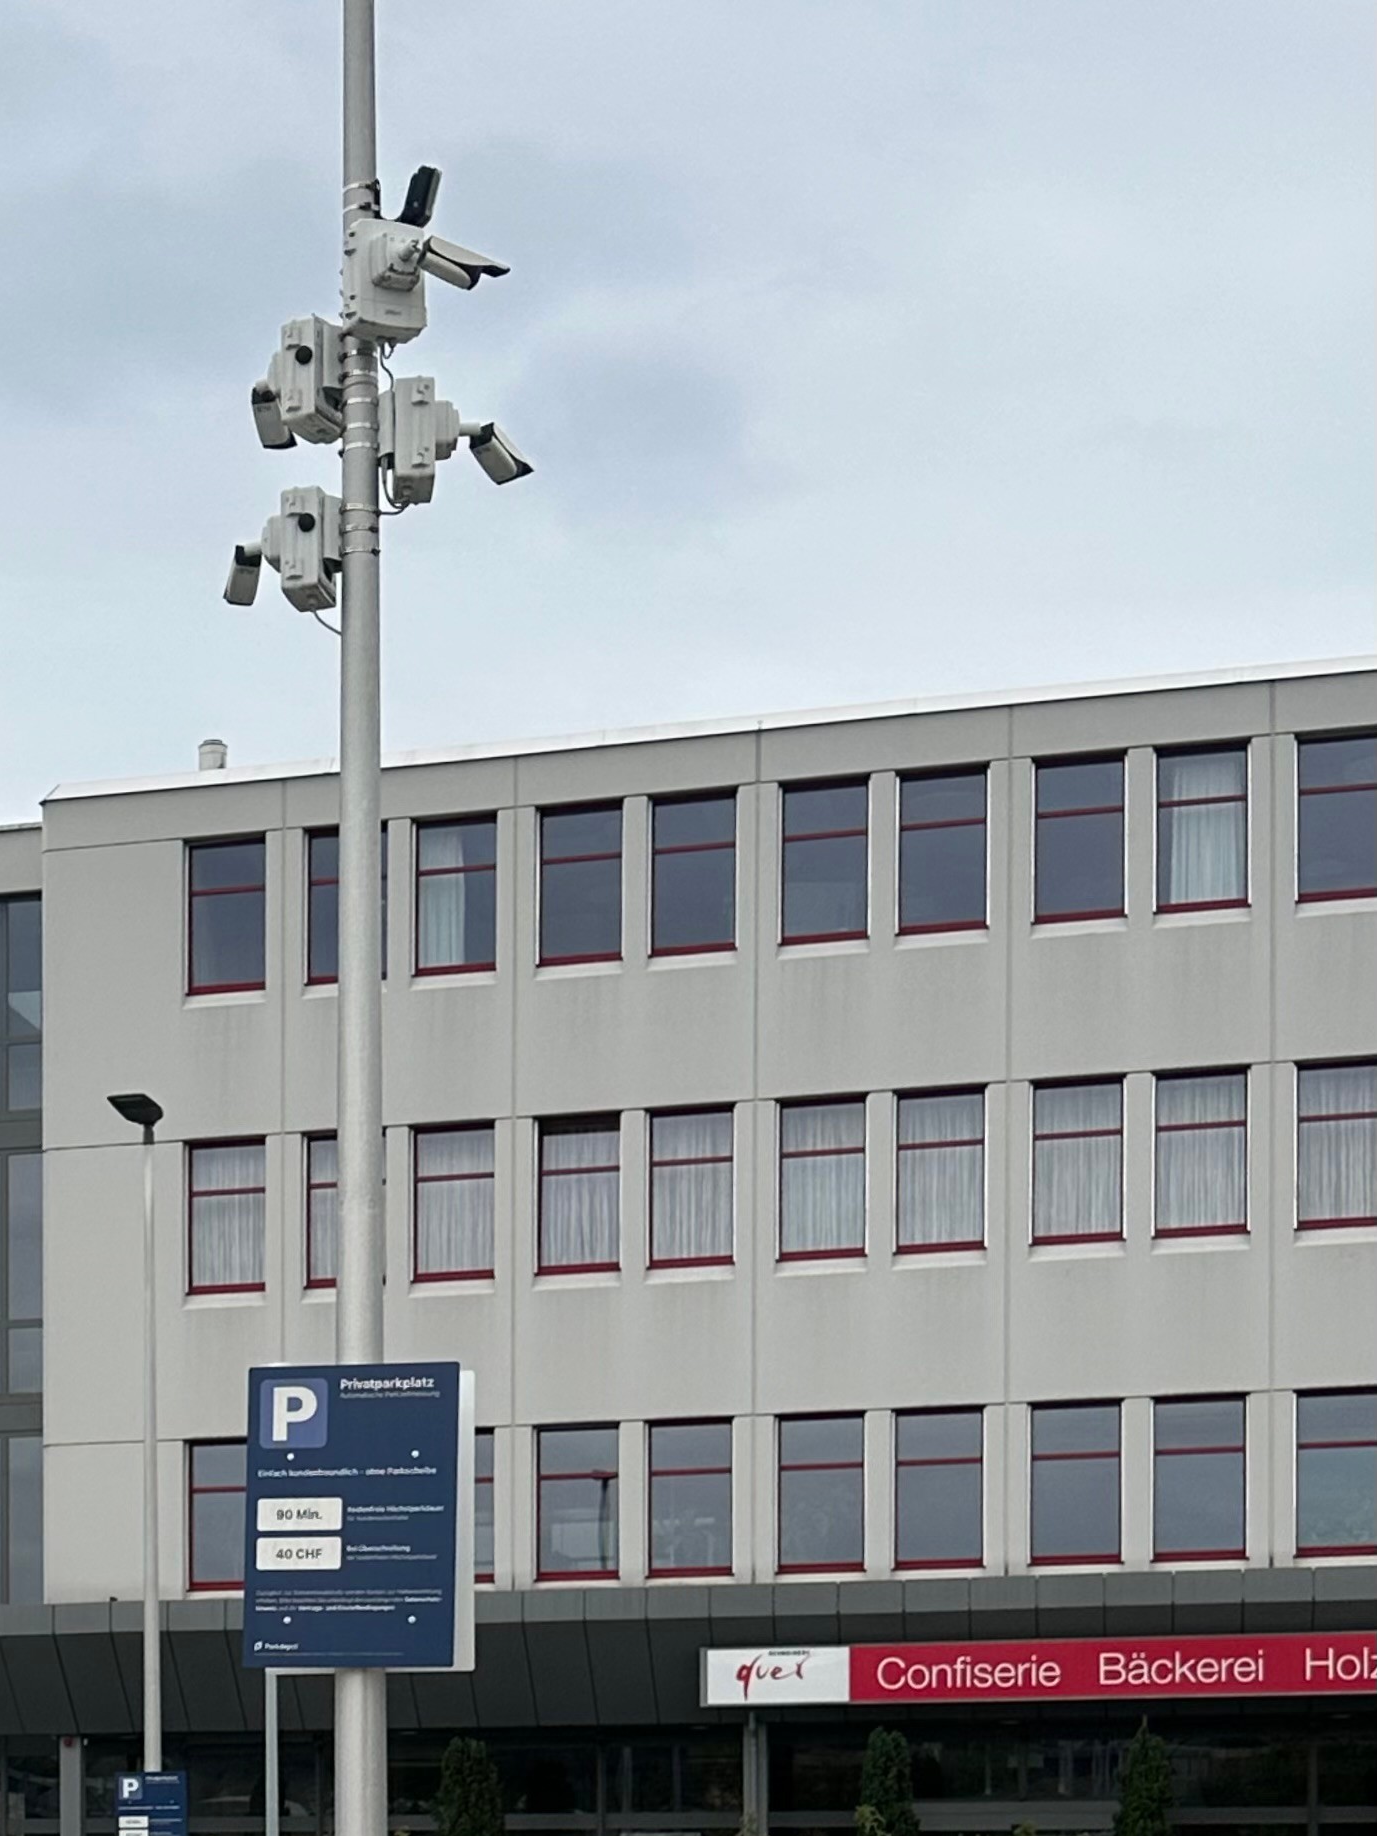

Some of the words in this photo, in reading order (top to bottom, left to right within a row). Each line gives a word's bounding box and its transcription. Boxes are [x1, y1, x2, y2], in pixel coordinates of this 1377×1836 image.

[339, 1376, 435, 1391] Privatparkplatz
[272, 1386, 318, 1442] P
[275, 1548, 293, 1560] 40
[295, 1548, 323, 1560] CHF
[876, 1654, 1062, 1690] Confiserie
[1098, 1649, 1264, 1685] Bäckerei
[122, 1778, 140, 1798] P
